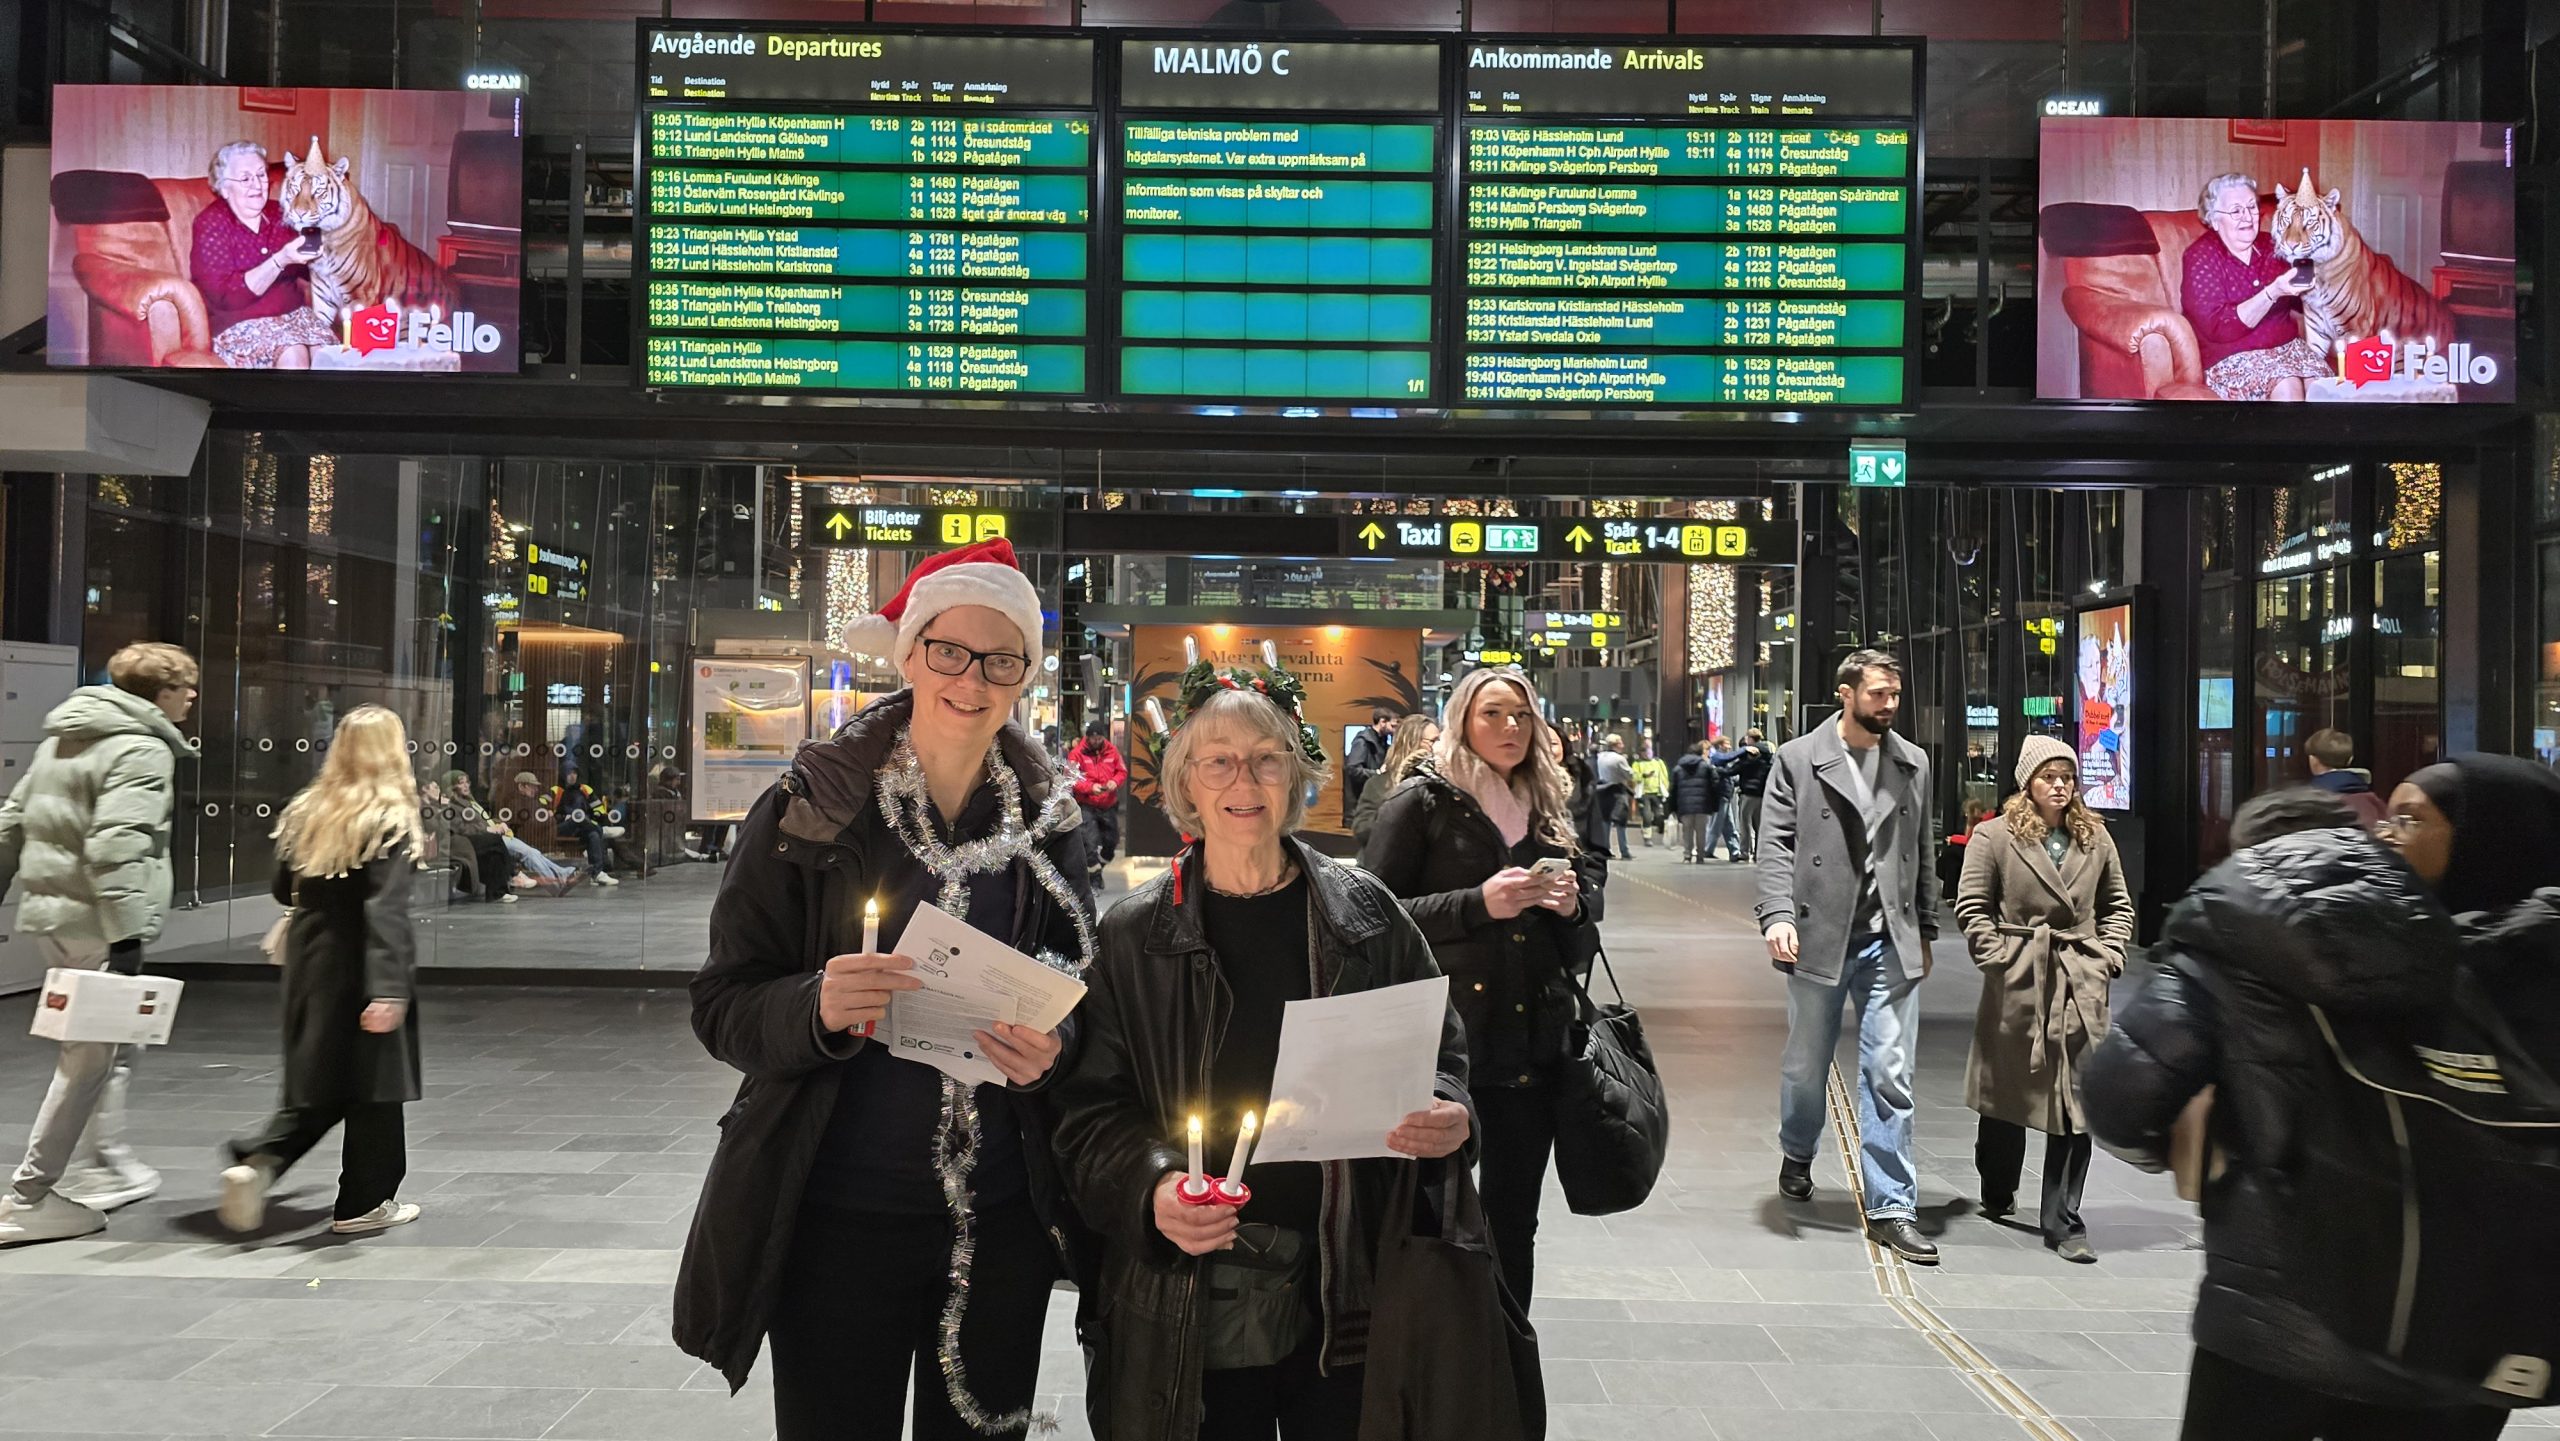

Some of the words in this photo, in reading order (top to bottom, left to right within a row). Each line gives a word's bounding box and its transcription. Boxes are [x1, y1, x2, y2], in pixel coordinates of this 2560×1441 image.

[651, 32, 755, 58] Avgående
[768, 36, 881, 61] Departures
[1155, 44, 1262, 74] MALMÖ
[1272, 49, 1289, 75] C
[1470, 47, 1612, 69] Ankommande
[1624, 49, 1700, 69] Arrivals
[467, 75, 520, 89] OCEAN
[685, 77, 725, 85] Destination
[2045, 100, 2099, 115] OCEAN
[653, 114, 681, 126] 19:05
[684, 115, 734, 129] Triangeln
[737, 116, 766, 130] Hyllie
[769, 117, 832, 134] Köpenhamn
[835, 119, 844, 129] H
[870, 119, 899, 131] 19:18
[911, 120, 924, 131] 2b
[931, 121, 955, 132] 1121
[653, 129, 682, 141] 19:12
[684, 130, 711, 142] Lund
[714, 131, 775, 143] Landskrona
[778, 132, 828, 147] Göteborg
[911, 135, 924, 146] 4a
[931, 136, 956, 147] 1114
[964, 132, 1031, 152] Öresundståg
[1128, 127, 1175, 142] Tillfälliga
[1177, 128, 1222, 140] tekniska
[1224, 129, 1270, 142] problem
[1273, 130, 1298, 142] med
[1470, 129, 1499, 141] 19:03
[1502, 130, 1530, 143] Växjö
[1533, 130, 1594, 142] Hässleholm
[1597, 131, 1623, 142] Lund
[1687, 132, 1714, 143] 19:11
[1728, 132, 1741, 143] 2b
[1748, 132, 1773, 143] 1121
[1127, 151, 1223, 165] högtalarsystemet.
[1226, 152, 1246, 164] Var
[1248, 154, 1275, 164] extra
[1278, 154, 1349, 167] uppmärksam
[1351, 153, 1365, 168] på
[652, 170, 680, 182] 19:16
[683, 172, 722, 183] Lomma
[725, 172, 771, 184] Furulund
[774, 174, 819, 187] Kävlinge
[911, 176, 923, 187] 3a
[930, 177, 956, 188] 1480
[963, 177, 1019, 193] Pågatågen
[1126, 184, 1187, 196] information
[1190, 188, 1214, 197] som
[1216, 186, 1245, 198] visas
[1248, 185, 1263, 200] på
[1264, 186, 1300, 200] skyltar
[1301, 187, 1323, 199] och
[1470, 186, 1498, 197] 19:14
[1501, 186, 1547, 200] Kävlinge
[1549, 187, 1596, 199] Furulund
[1598, 188, 1637, 199] Lomma
[1728, 189, 1740, 200] 1a
[1747, 189, 1773, 200] 1429
[1780, 189, 1837, 205] Pågatågen
[1840, 189, 1899, 203] Spårändrat
[1126, 207, 1181, 219] monitorer.
[1469, 217, 1498, 228] 19:19
[1500, 217, 1529, 230] Hyllie
[1532, 217, 1581, 231] Triangeln
[1726, 220, 1739, 231] 3a
[1746, 220, 1772, 231] 1528
[1779, 220, 1836, 233] Pågatågen
[650, 242, 679, 254] 19:24
[682, 243, 709, 255] Lund
[712, 244, 773, 256] Hässleholm
[776, 245, 837, 258] Kristianstad
[909, 248, 923, 259] 4a
[930, 249, 955, 260] 1232
[962, 249, 1018, 265] Pågatågen
[1468, 258, 1497, 269] 19:22
[1499, 258, 1553, 275] Trelleborg
[1555, 259, 1566, 270] V.
[1569, 260, 1617, 276] Ingelstad
[1619, 260, 1677, 277] Svågertorp
[1725, 261, 1739, 272] 4a
[1746, 261, 1771, 272] 1232
[1778, 261, 1835, 277] Pågatågen
[649, 284, 678, 295] 19:35
[681, 284, 732, 301] Triangeln
[734, 286, 763, 302] Hyllie
[766, 286, 829, 303] Köpenhamn
[832, 288, 841, 298] H
[909, 289, 922, 300] 1b
[929, 290, 954, 301] 1125
[962, 288, 1028, 306] Öresundståg
[1467, 299, 1496, 311] 19:33
[1499, 300, 1556, 311] Karlskrona
[1558, 301, 1620, 312] Kristianstad
[1622, 301, 1683, 312] Hässleholm
[1726, 302, 1739, 313] 1b
[1746, 302, 1771, 313] 1125
[1778, 301, 1846, 316] Öresundståg
[407, 312, 501, 353] Fello
[650, 314, 679, 326] 19:39
[681, 315, 708, 326] Lund
[711, 315, 772, 327] Landskrona
[776, 317, 839, 331] Helsingborg
[909, 320, 922, 331] 3a
[929, 320, 954, 331] 1728
[962, 320, 1017, 335] Pågatågen
[1467, 330, 1496, 341] 19:37
[1498, 330, 1528, 341] Ystad
[1531, 331, 1574, 342] Svedala
[1576, 331, 1600, 342] Oxie
[1724, 332, 1737, 344] 3a
[1744, 333, 1770, 344] 1728
[1777, 332, 1834, 346] Pågatågen
[2404, 344, 2498, 385] Fello
[1465, 386, 1493, 398] 19:41
[1497, 387, 1542, 400] Kävlinge
[1545, 387, 1603, 401] Svågertorp
[1605, 388, 1653, 401] Persborg
[1724, 389, 1735, 400] 11
[1743, 389, 1769, 400] 1429
[1776, 389, 1833, 403] Pågatågen
[865, 510, 920, 528] Biljetter
[865, 526, 912, 542] Tickets
[1398, 523, 1441, 546] Taxi
[1604, 522, 1639, 539] Spår
[1645, 526, 1679, 548] 1-4
[1604, 539, 1641, 554] Track
[1211, 651, 1246, 663] Mer
